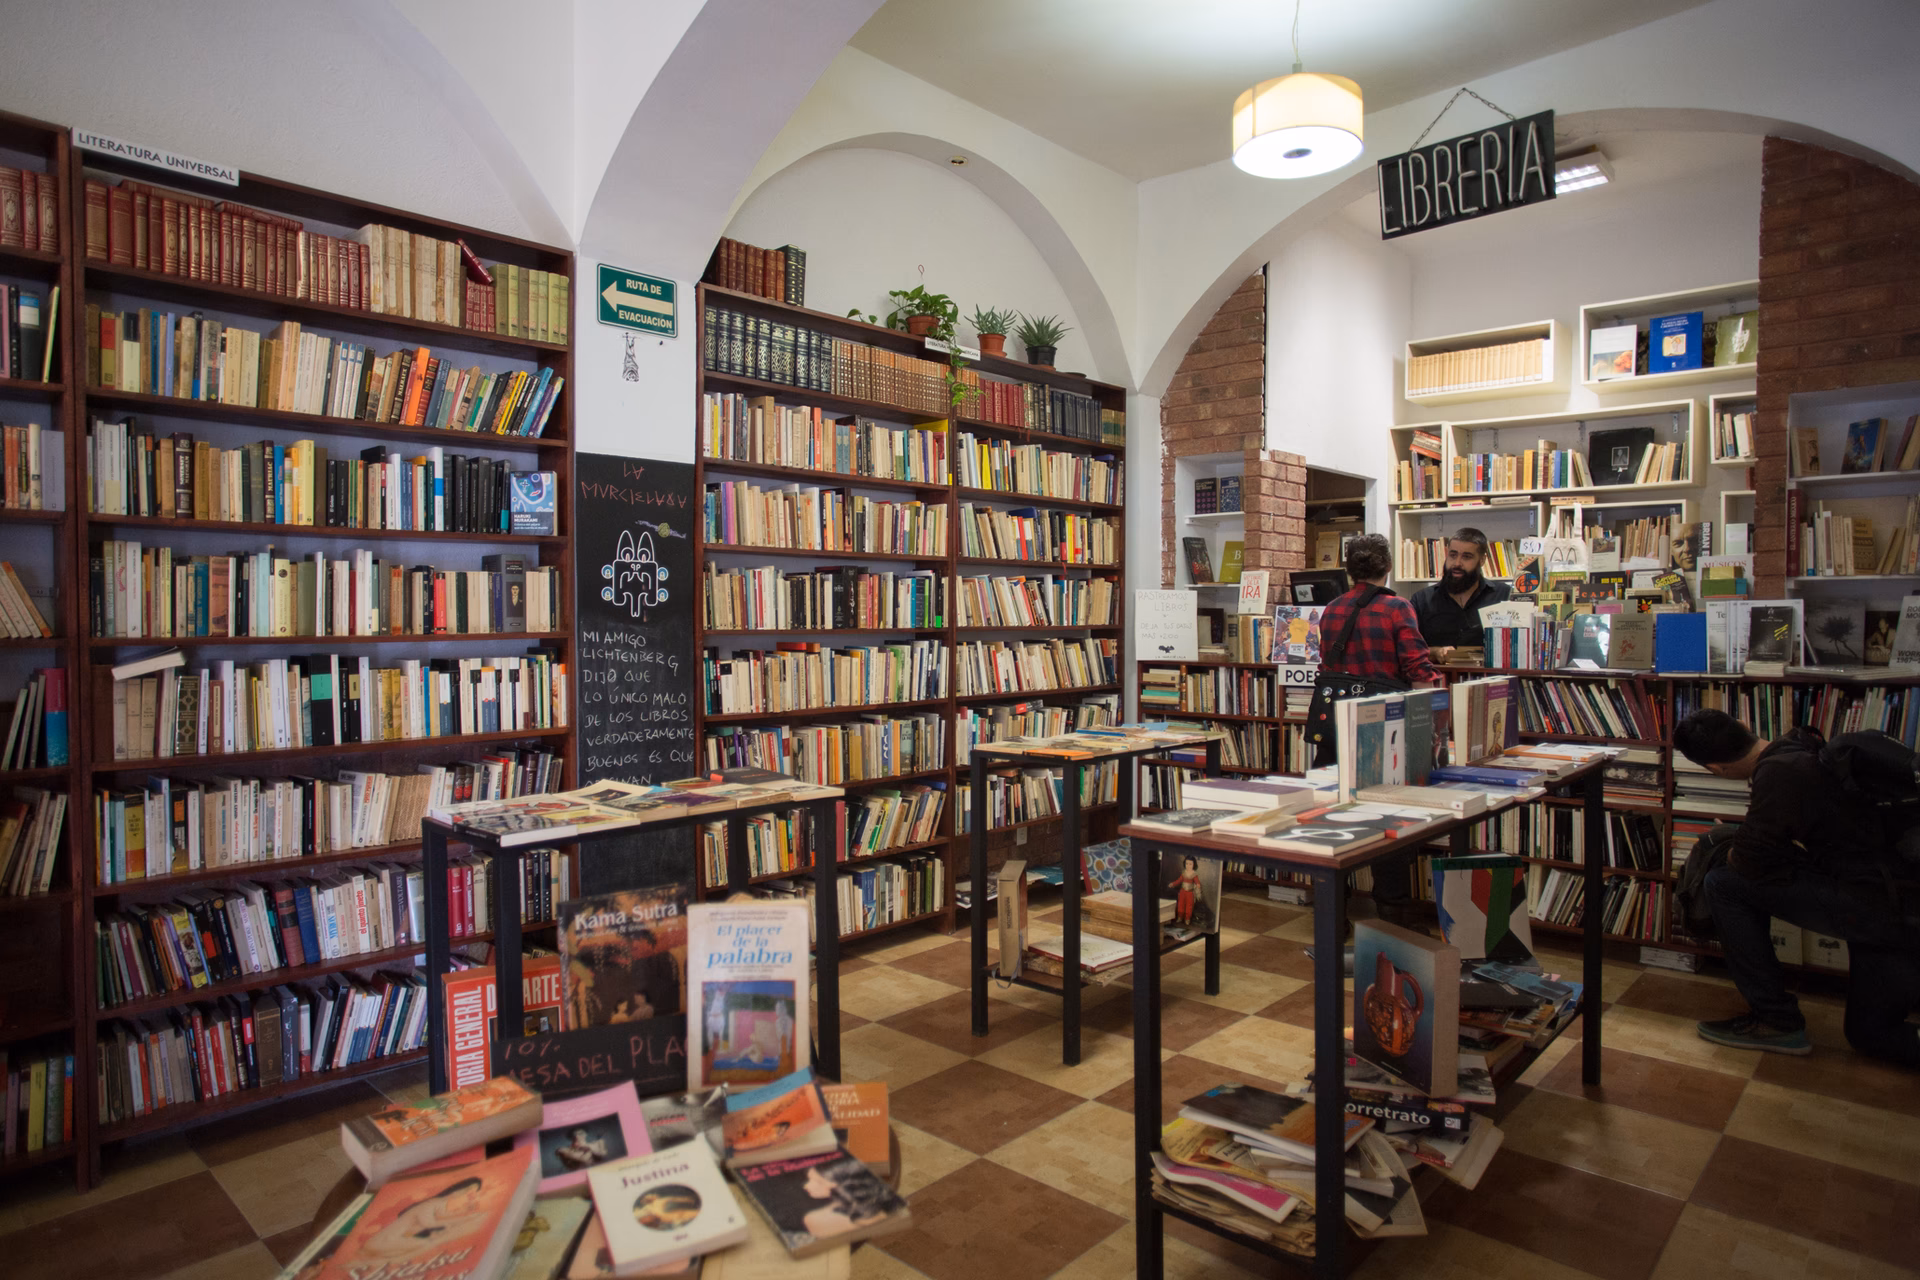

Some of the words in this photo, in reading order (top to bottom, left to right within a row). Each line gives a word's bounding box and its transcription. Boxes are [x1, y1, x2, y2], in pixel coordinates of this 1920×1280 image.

[77, 132, 164, 164] LITERATURA
[166, 154, 236, 182] UNIVERSAL
[1378, 119, 1547, 234] LIBRERIA
[625, 278, 649, 293] RUTA
[650, 284, 662, 296] DE
[618, 309, 673, 329] EVACUACION
[397, 367, 408, 396] MALRAUX
[1703, 522, 1711, 548] BRIAN
[1241, 586, 1261, 599] IRA
[1154, 602, 1189, 612] LIBROS
[583, 631, 599, 644] MI
[603, 632, 647, 649] AMIGO
[582, 669, 617, 685] DIJO
[624, 670, 652, 682] QUE
[584, 692, 602, 704] LO
[652, 692, 687, 707] MALO
[585, 714, 602, 728] DE
[609, 711, 633, 723] LOS
[640, 709, 689, 722] LIBROS
[586, 727, 694, 747] VERDADERAMENTE
[585, 753, 638, 772] BUENOS
[649, 749, 662, 764] ES
[670, 749, 694, 763] QUE
[355, 890, 367, 908] jinete
[395, 875, 404, 906] VOLTAIRE
[357, 908, 368, 928] quinto
[575, 909, 627, 933] Kama
[632, 902, 679, 926] Sutra
[717, 924, 733, 937] El
[736, 923, 783, 940] placer
[732, 936, 752, 948] de
[755, 936, 768, 948] la
[706, 948, 793, 969] palabra
[523, 973, 561, 1006] ARTE
[453, 985, 484, 1051] GENERAL
[578, 1053, 622, 1079] DEL
[619, 1161, 690, 1190] Justina
